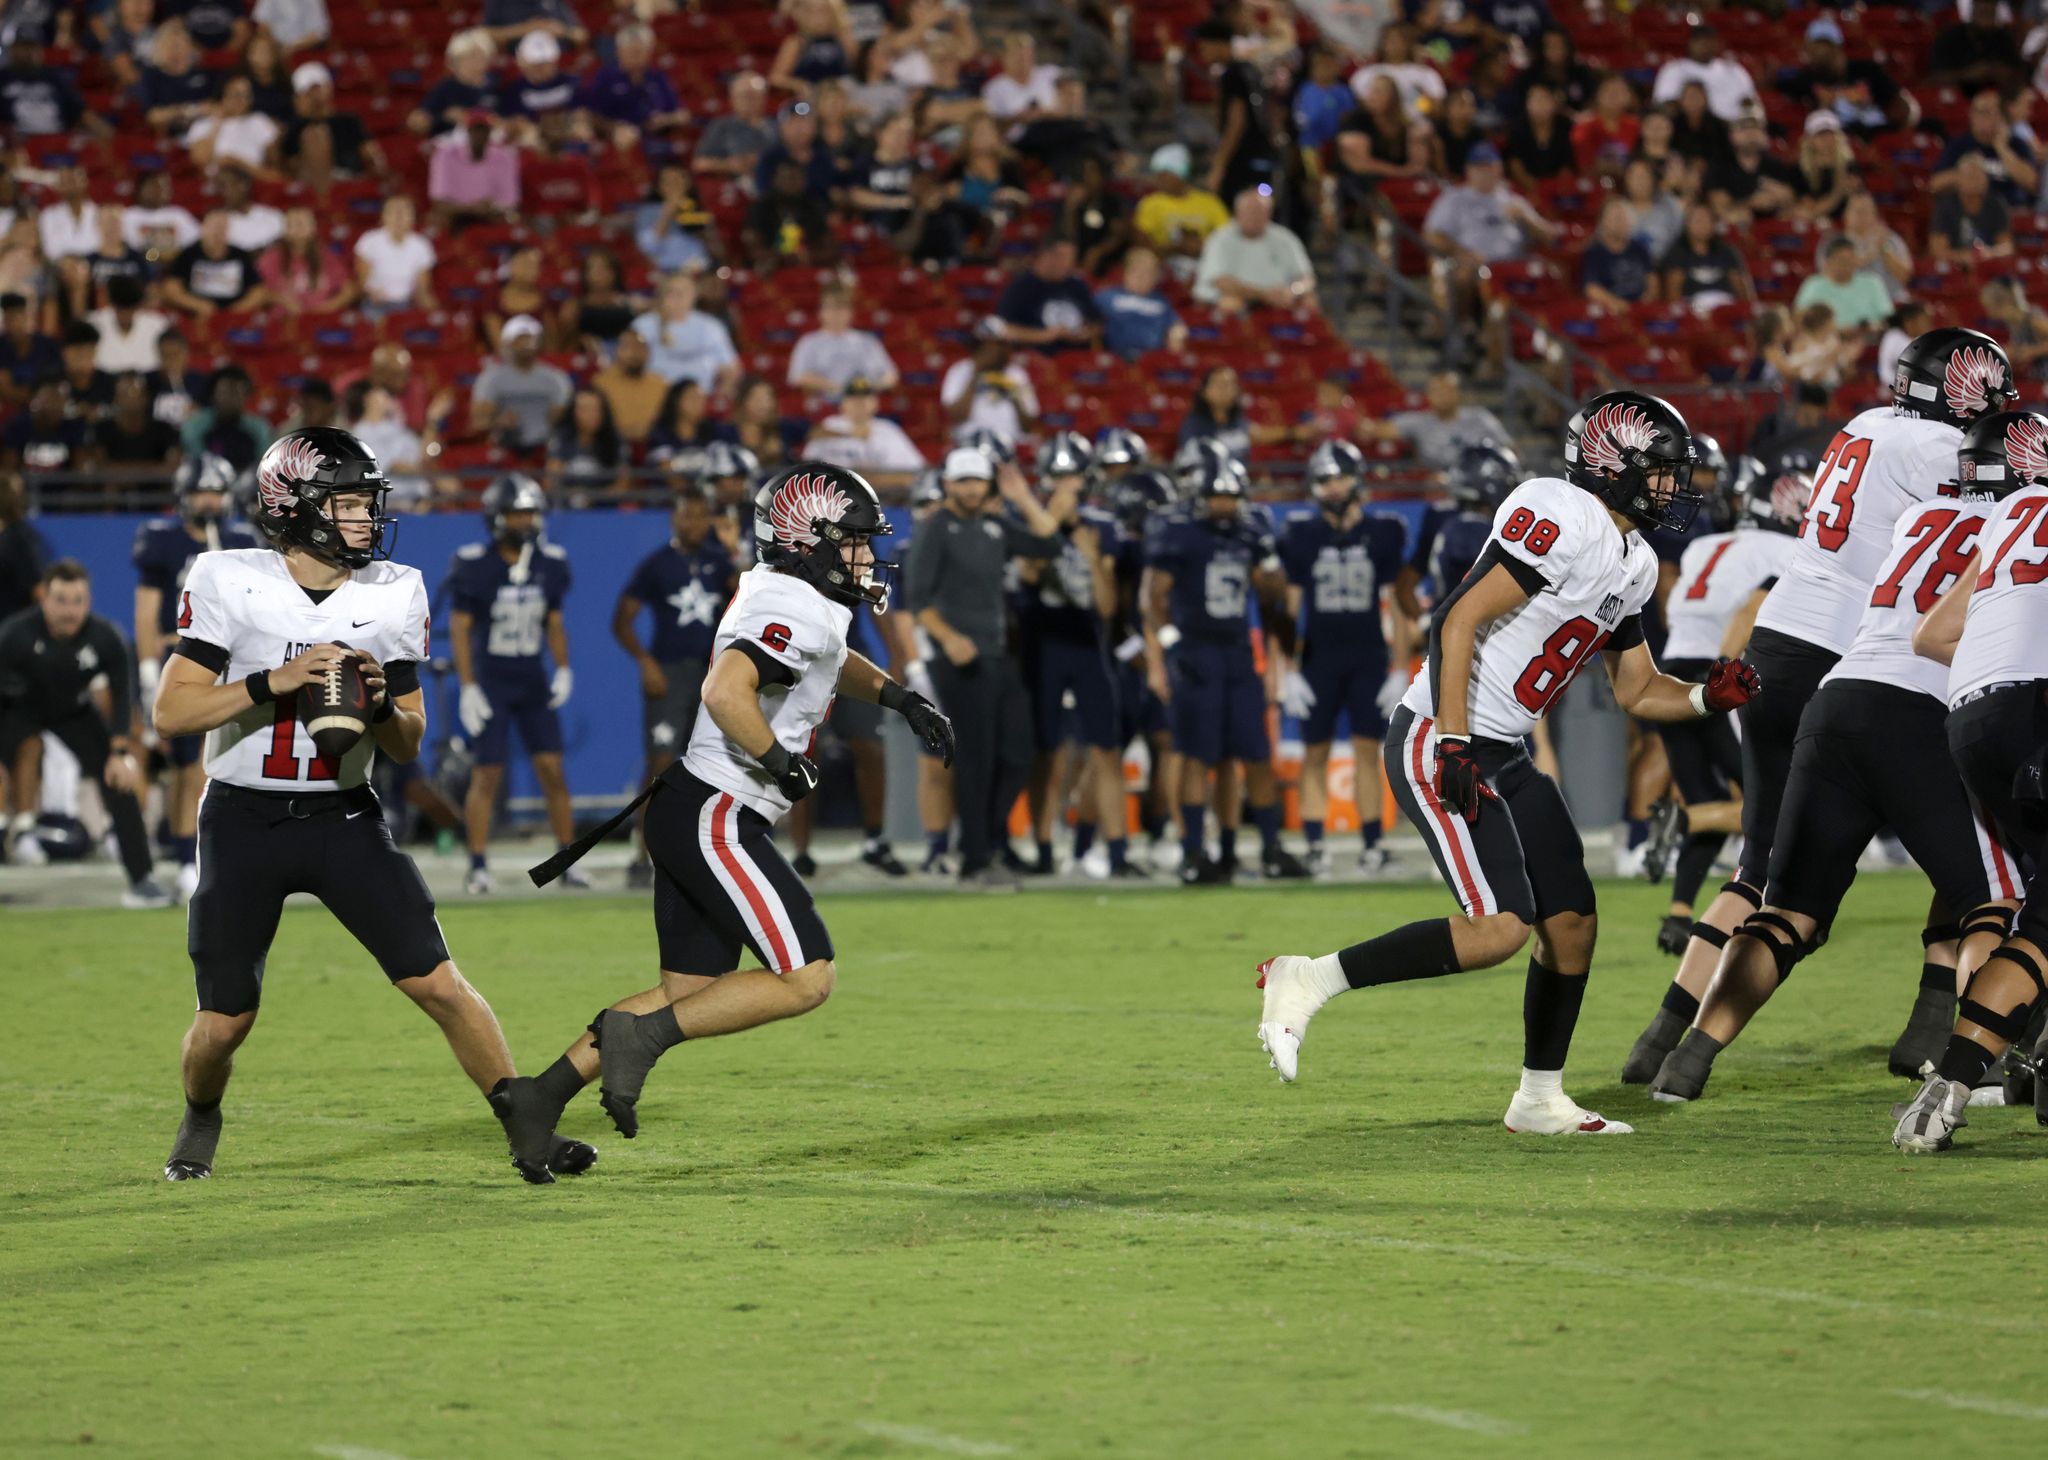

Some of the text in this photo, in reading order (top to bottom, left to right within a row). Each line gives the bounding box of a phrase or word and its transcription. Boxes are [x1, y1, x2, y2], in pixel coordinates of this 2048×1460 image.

[1501, 506, 1561, 557] 88
[1798, 430, 1874, 553] 73
[1870, 509, 1987, 615] 78
[1513, 614, 1613, 720] 8
